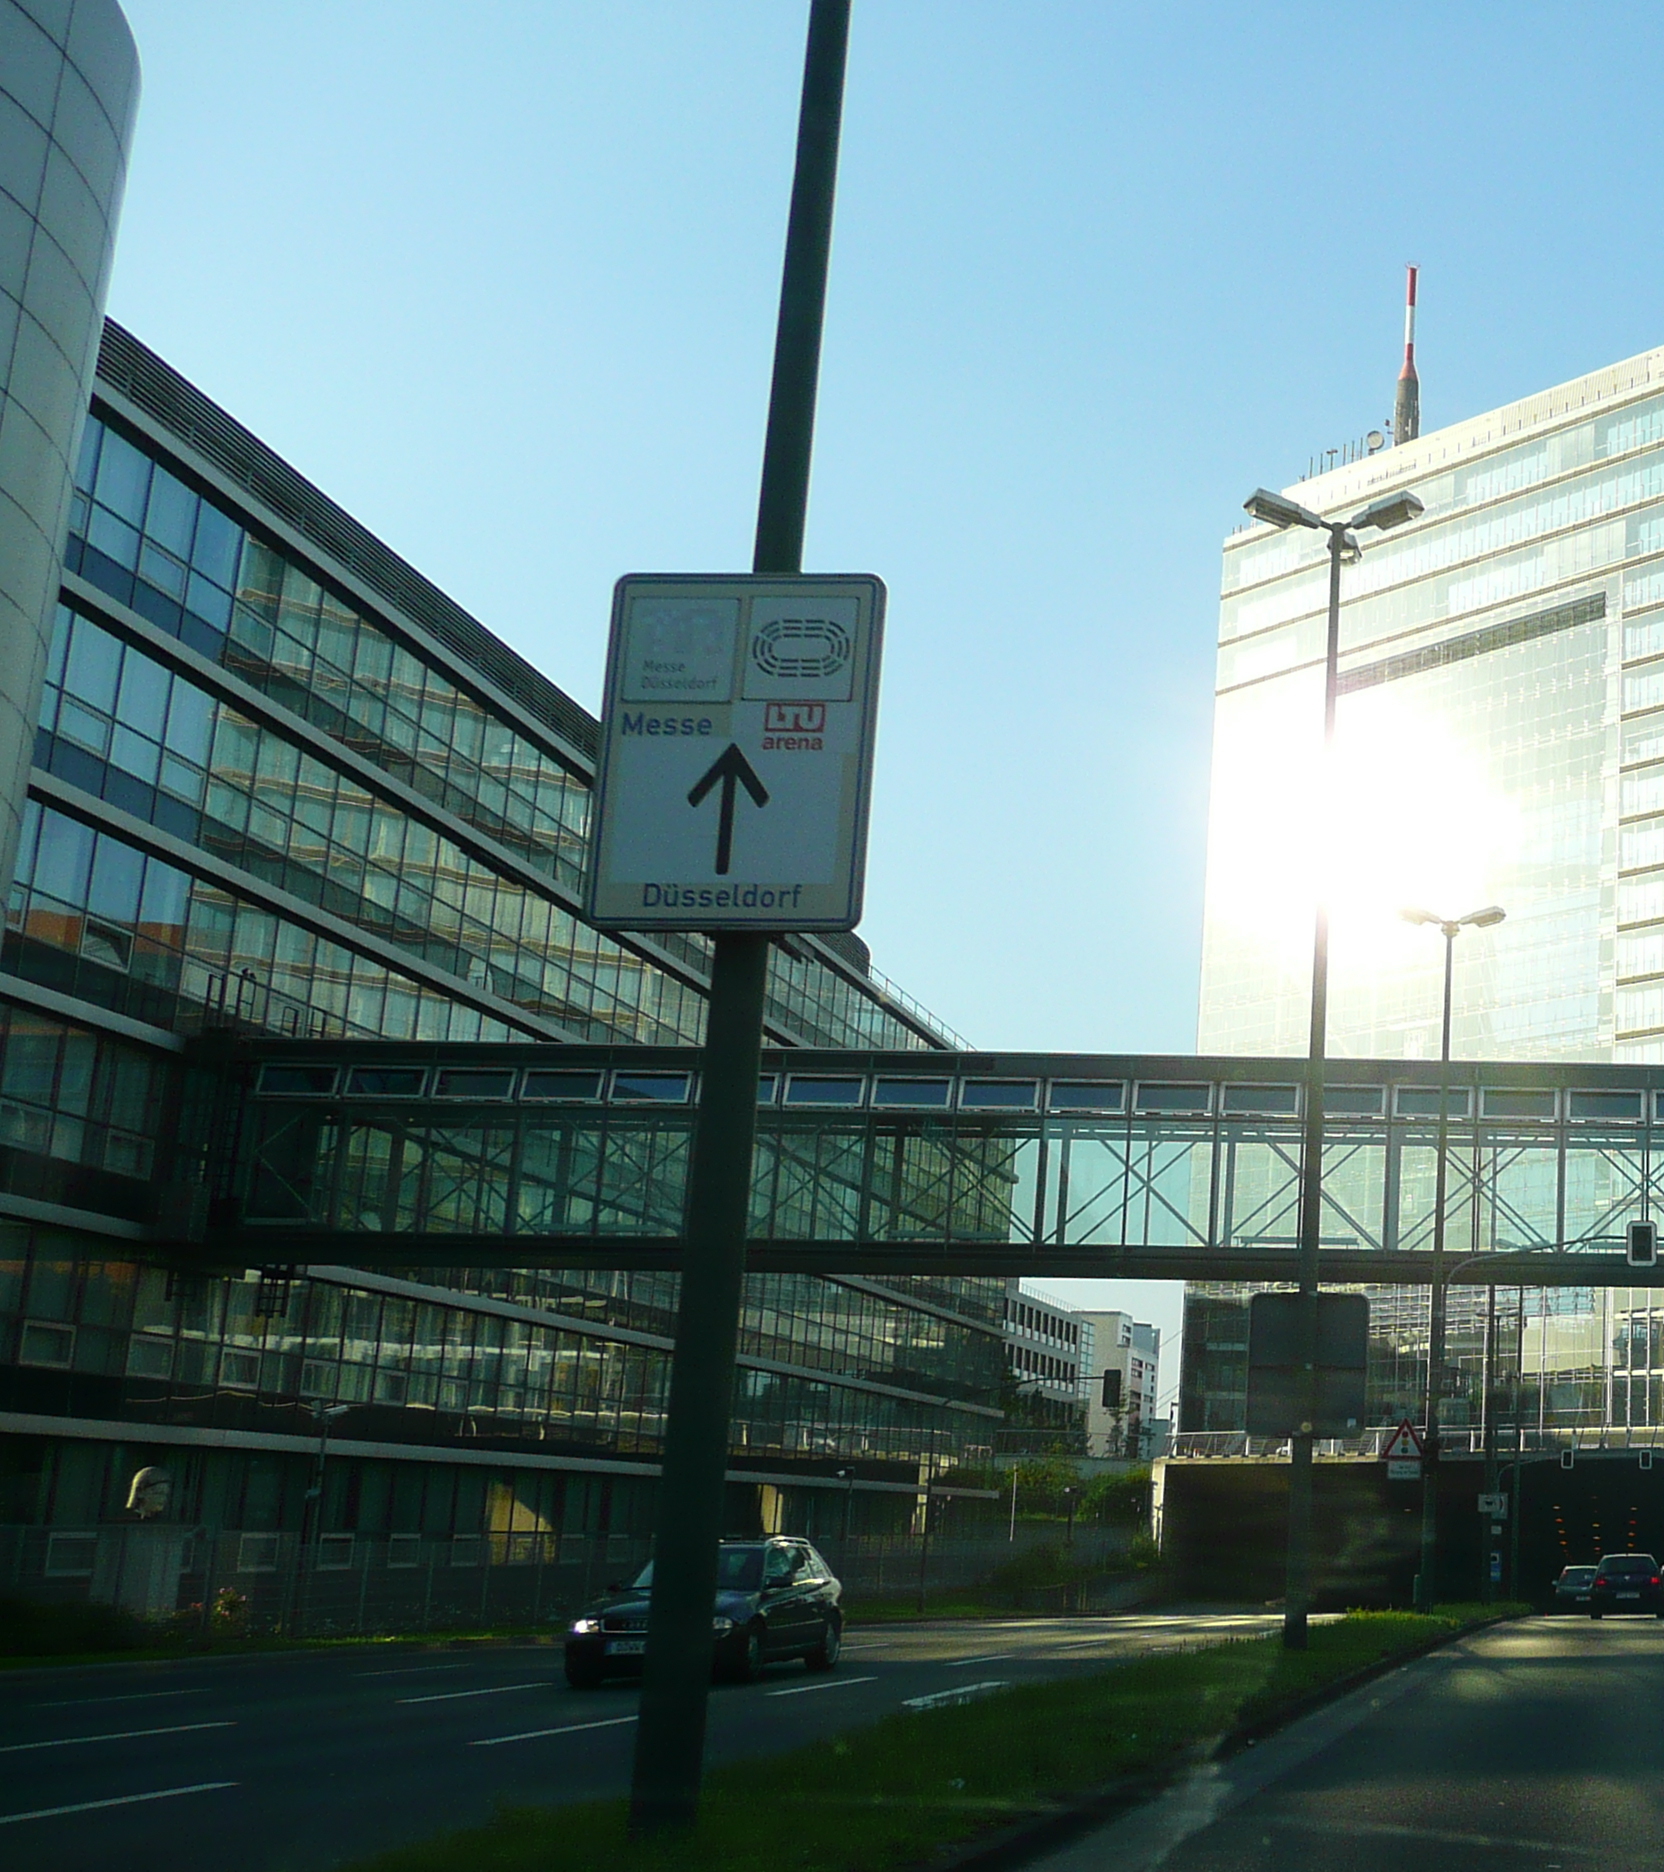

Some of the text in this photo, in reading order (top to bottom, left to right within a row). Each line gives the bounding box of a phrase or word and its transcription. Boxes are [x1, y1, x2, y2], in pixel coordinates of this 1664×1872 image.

[642, 659, 686, 673] Messe
[641, 674, 717, 690] Düsseldorf
[621, 711, 713, 736] Messe
[766, 703, 825, 732] LTU
[762, 736, 823, 751] arena
[642, 883, 803, 909] Düsseldorf
